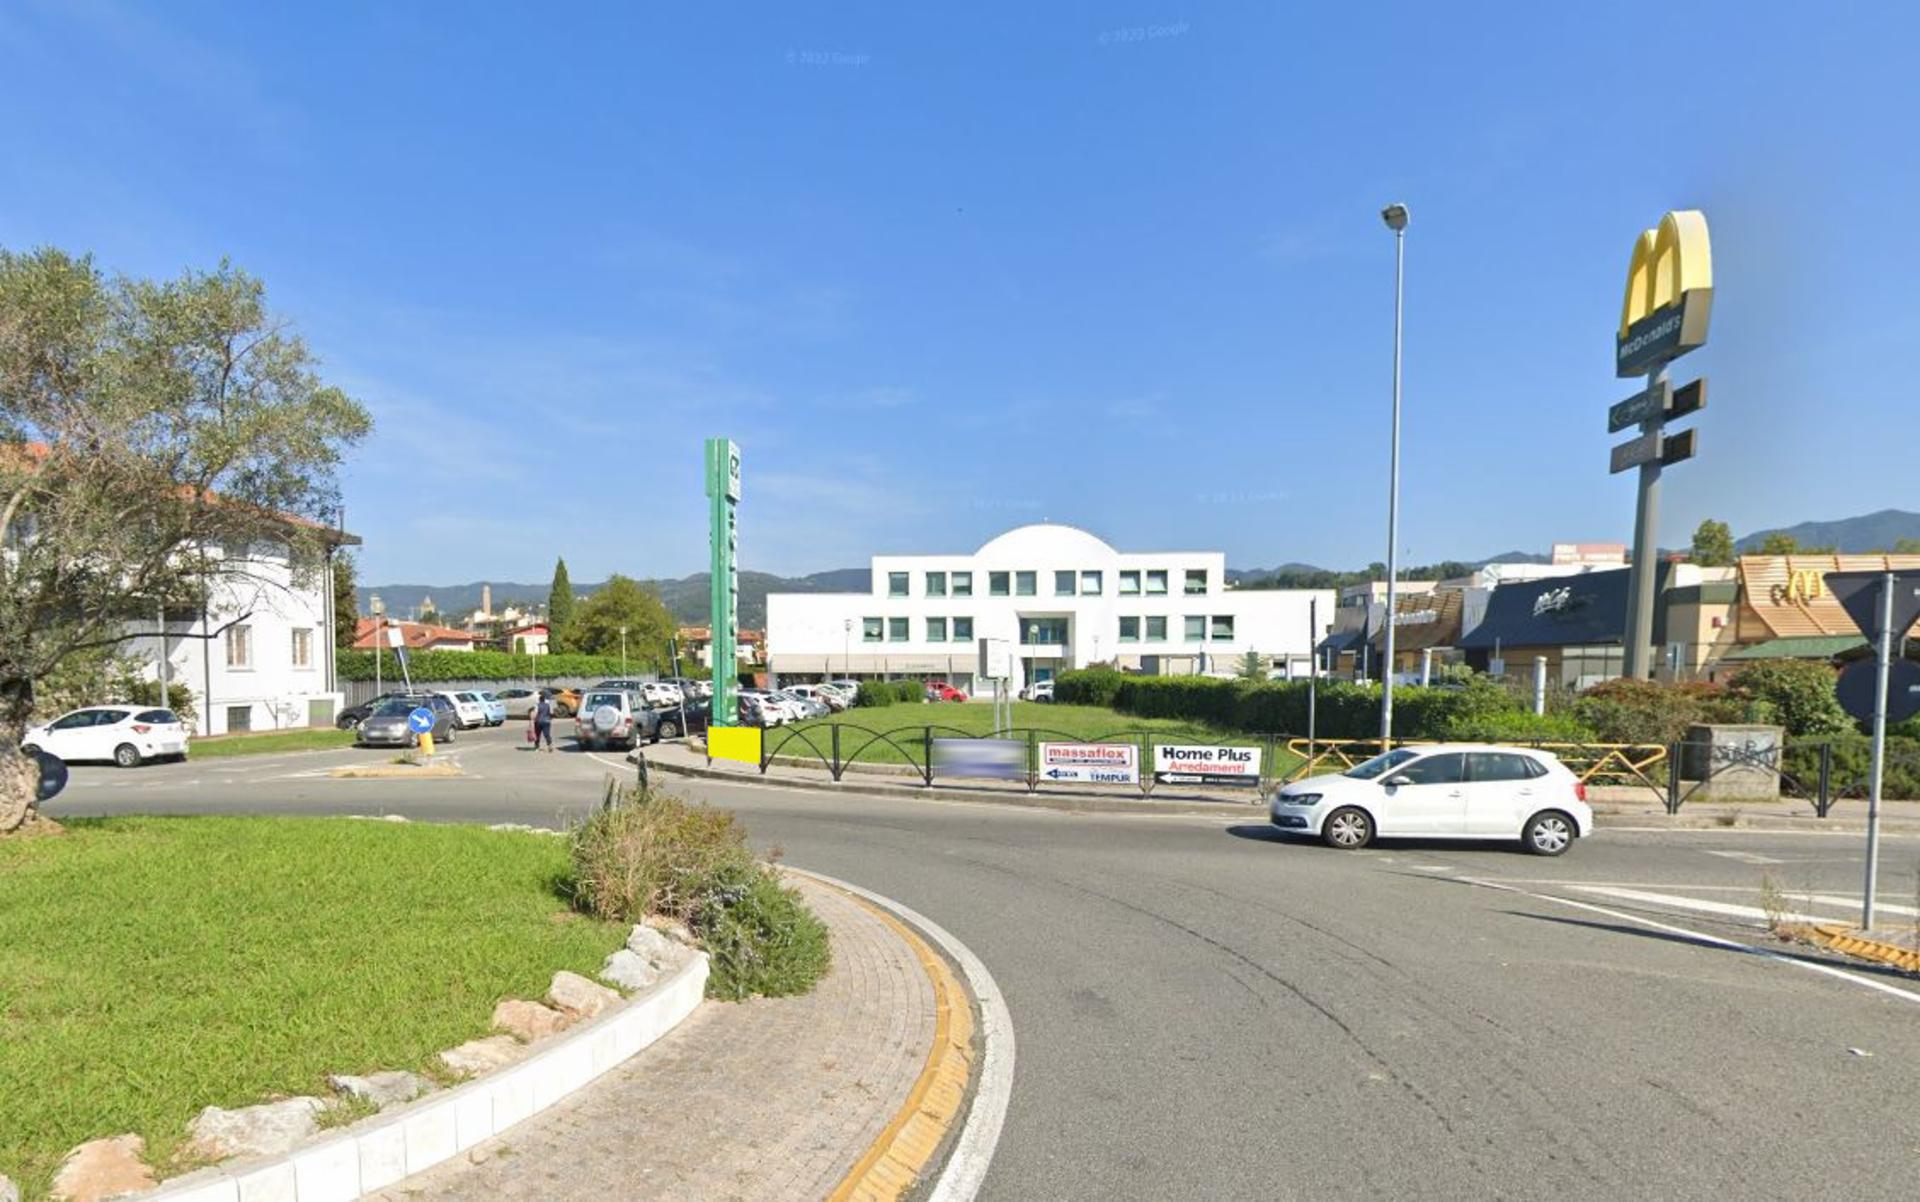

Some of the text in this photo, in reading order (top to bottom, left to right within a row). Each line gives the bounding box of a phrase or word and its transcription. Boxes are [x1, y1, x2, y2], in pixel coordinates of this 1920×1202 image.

[1162, 747, 1251, 761] Home Plus
[1169, 761, 1245, 773] Arredamenti
[1090, 773, 1131, 782] TEMPUR
